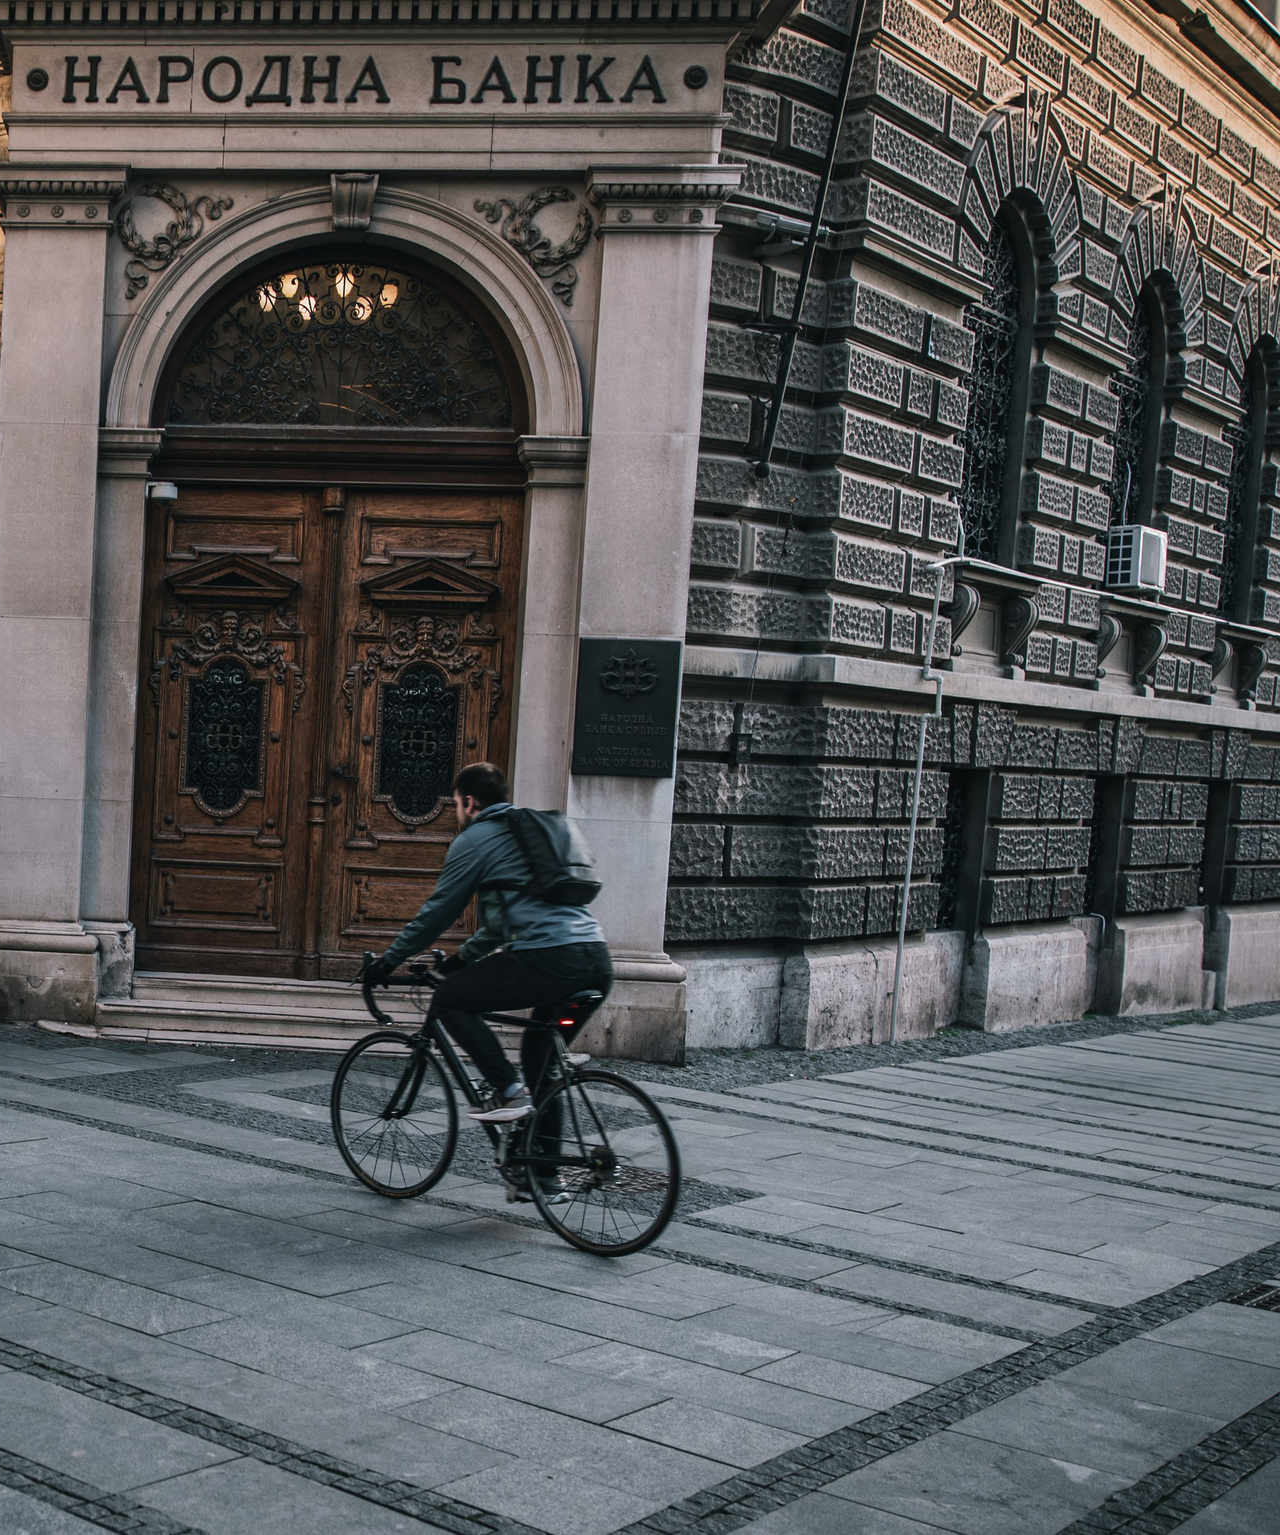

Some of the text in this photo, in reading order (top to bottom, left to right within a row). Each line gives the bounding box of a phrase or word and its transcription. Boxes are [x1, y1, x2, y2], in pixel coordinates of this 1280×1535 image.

[62, 53, 668, 107] НАРОДНА БАНКА
[600, 713, 653, 724] НАРОДНА
[584, 724, 667, 736] БАНКА СРБИЈЕ
[596, 746, 653, 757] NATIONAL
[579, 757, 669, 769] BANK OF SERBIA
